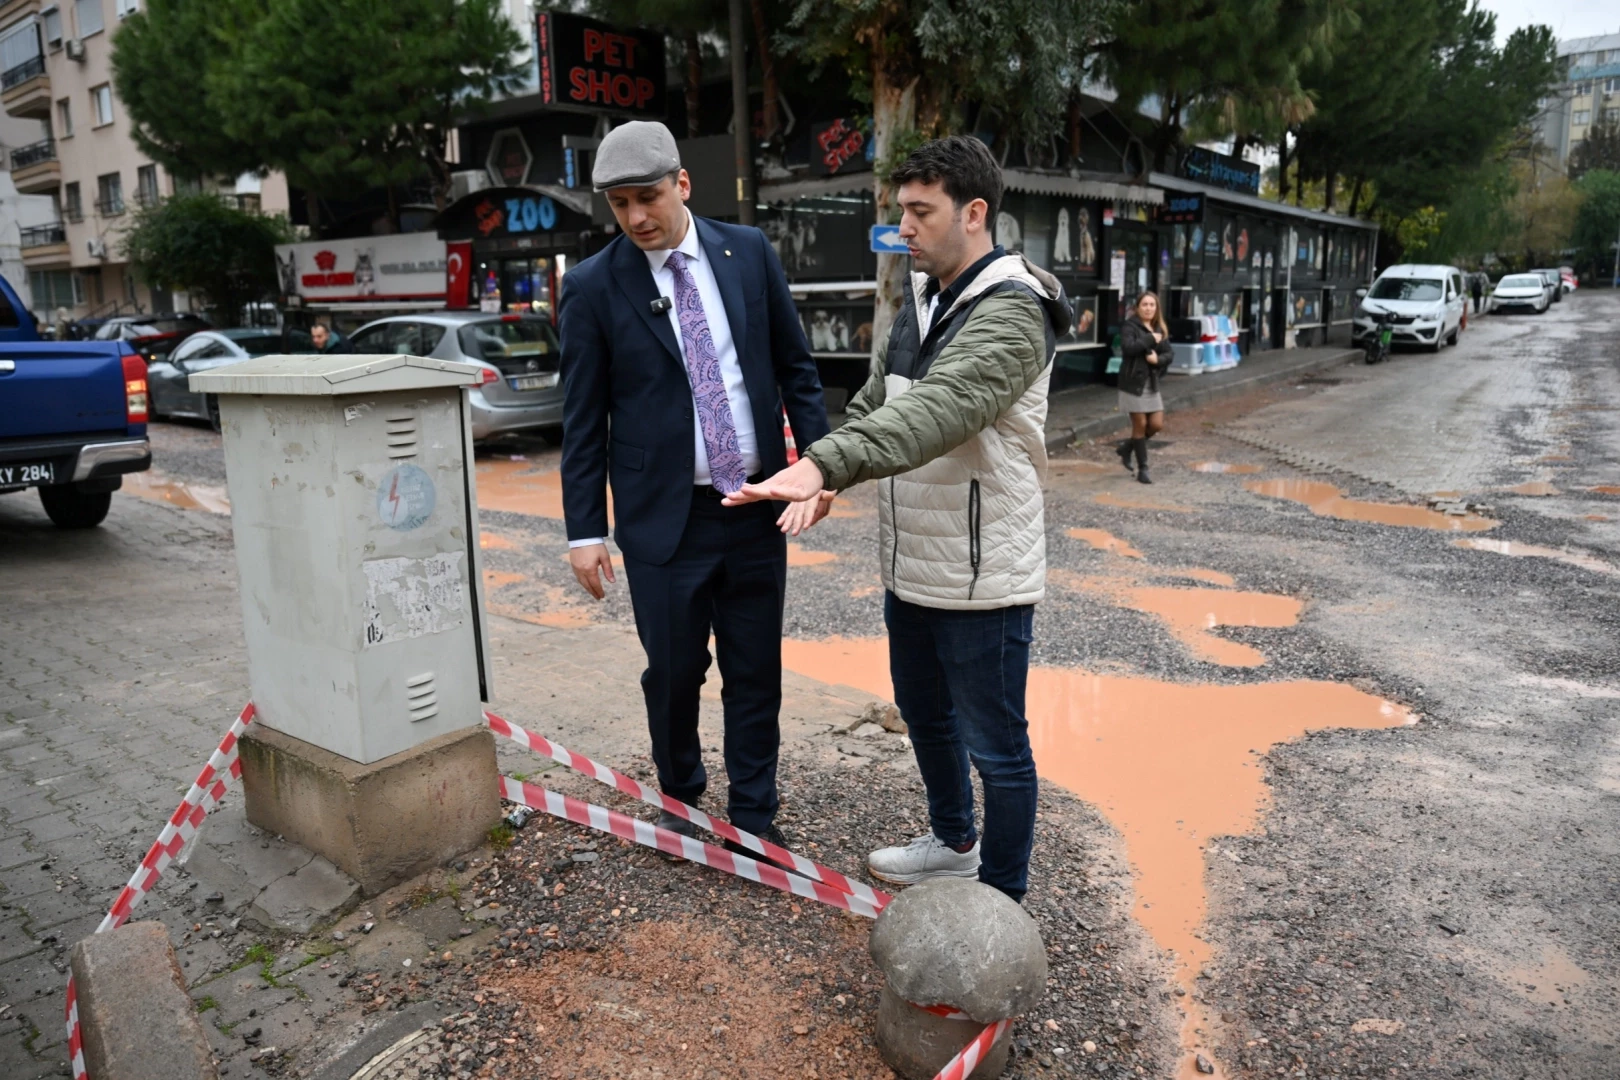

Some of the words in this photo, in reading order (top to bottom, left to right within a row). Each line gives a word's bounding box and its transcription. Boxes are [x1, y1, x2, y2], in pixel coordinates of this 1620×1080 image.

[584, 29, 638, 68] PET
[570, 67, 654, 109] SHOP
[504, 195, 556, 233] ZOO
[20, 464, 50, 481] 284
